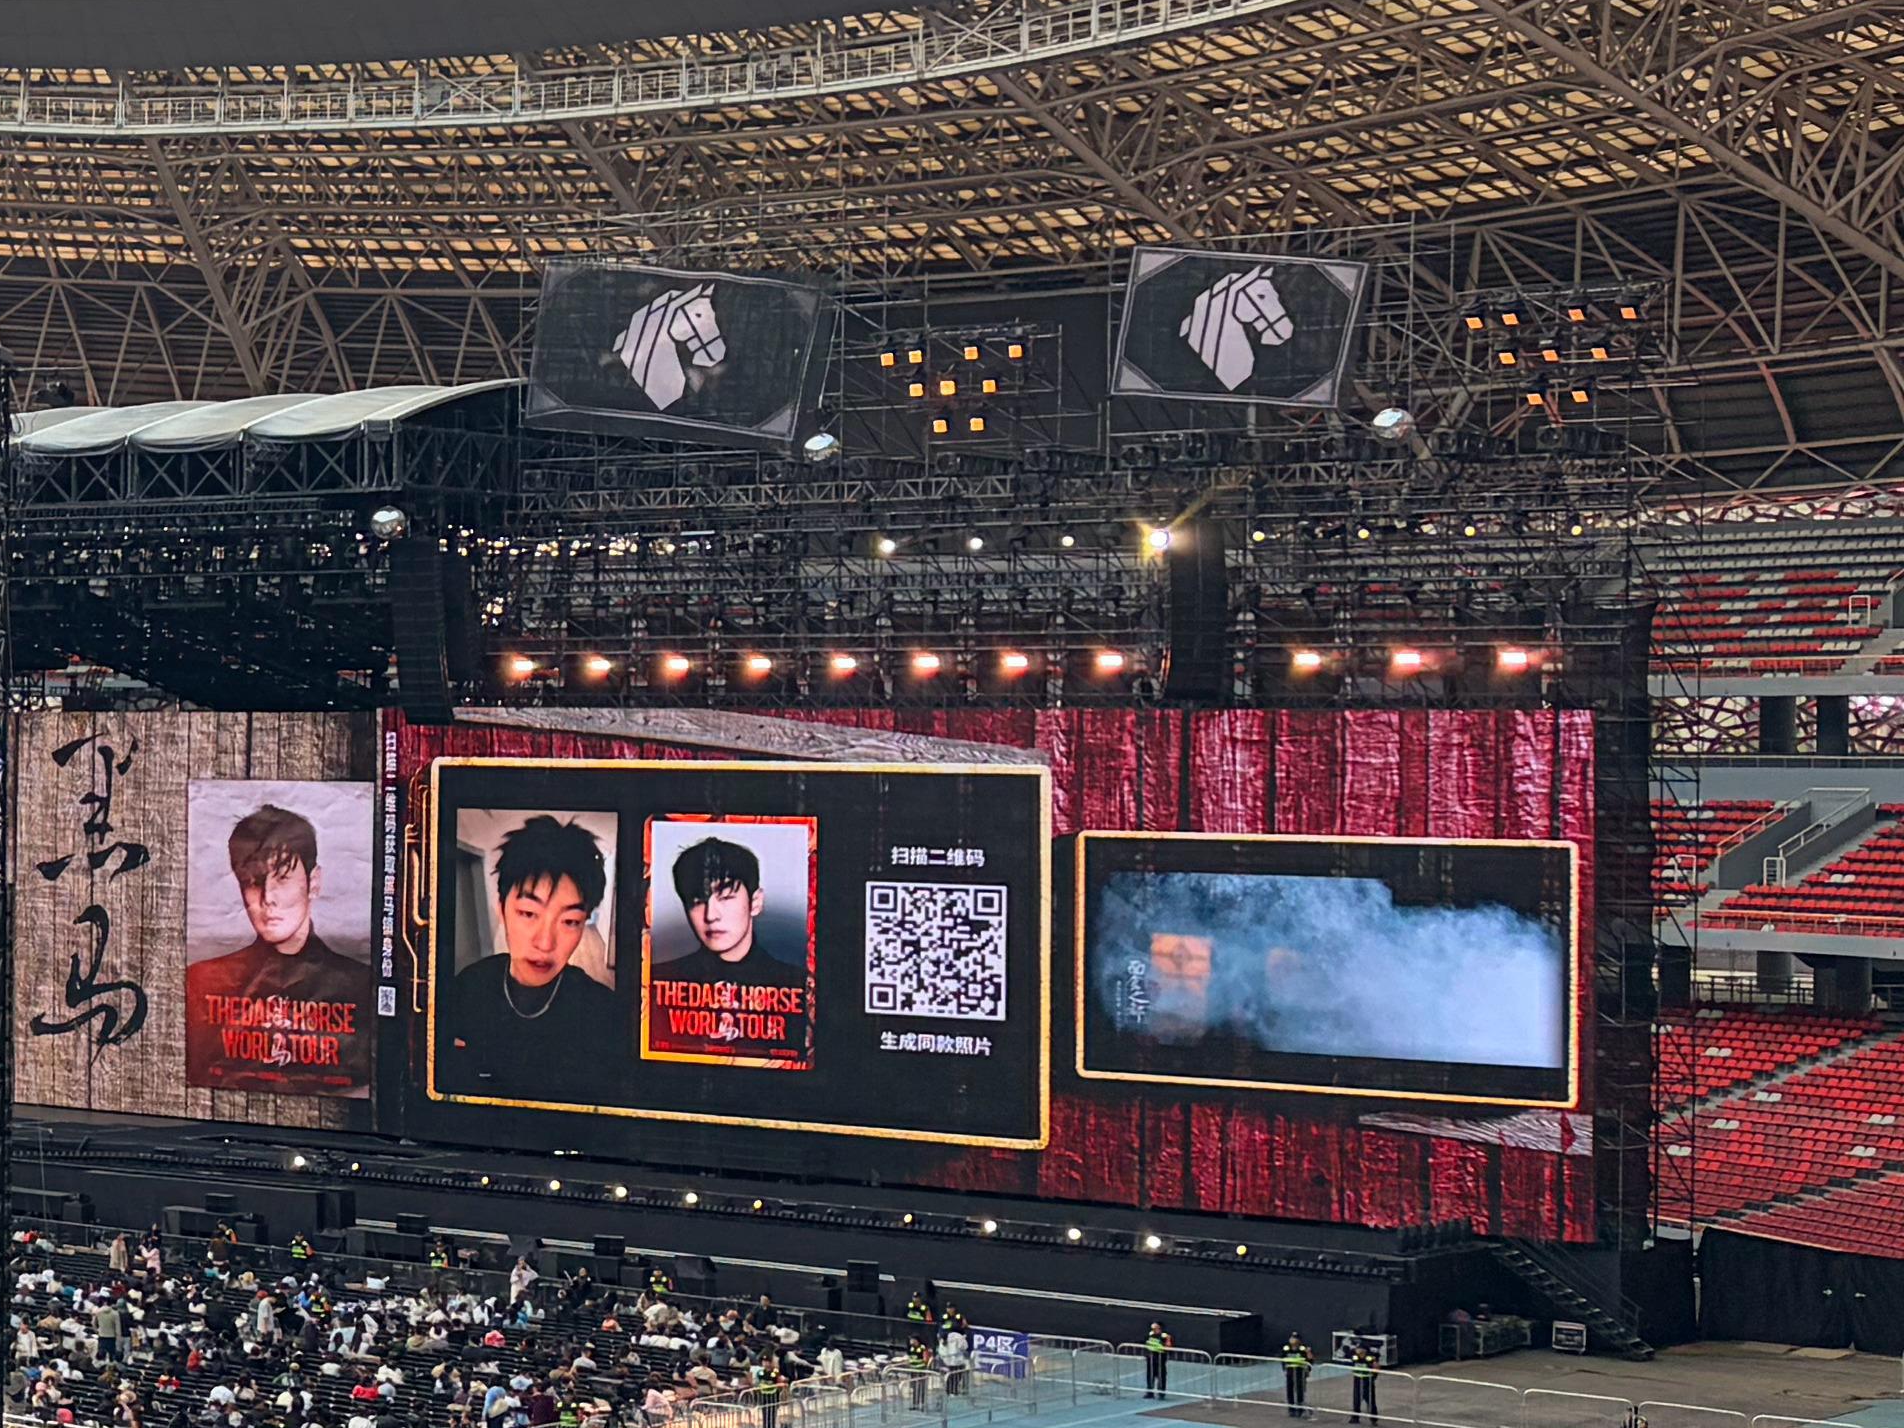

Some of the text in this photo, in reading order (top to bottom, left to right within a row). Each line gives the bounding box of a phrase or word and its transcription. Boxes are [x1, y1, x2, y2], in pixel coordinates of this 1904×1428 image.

[890, 845, 986, 868] 扫描二维码
[742, 985, 804, 1014] HORSE
[292, 1000, 357, 1034] HORSE
[738, 1013, 787, 1041] TOUR
[289, 1033, 340, 1067] TOUR
[879, 1030, 993, 1057] 生成同款照片
[972, 1334, 1015, 1355] P4区
